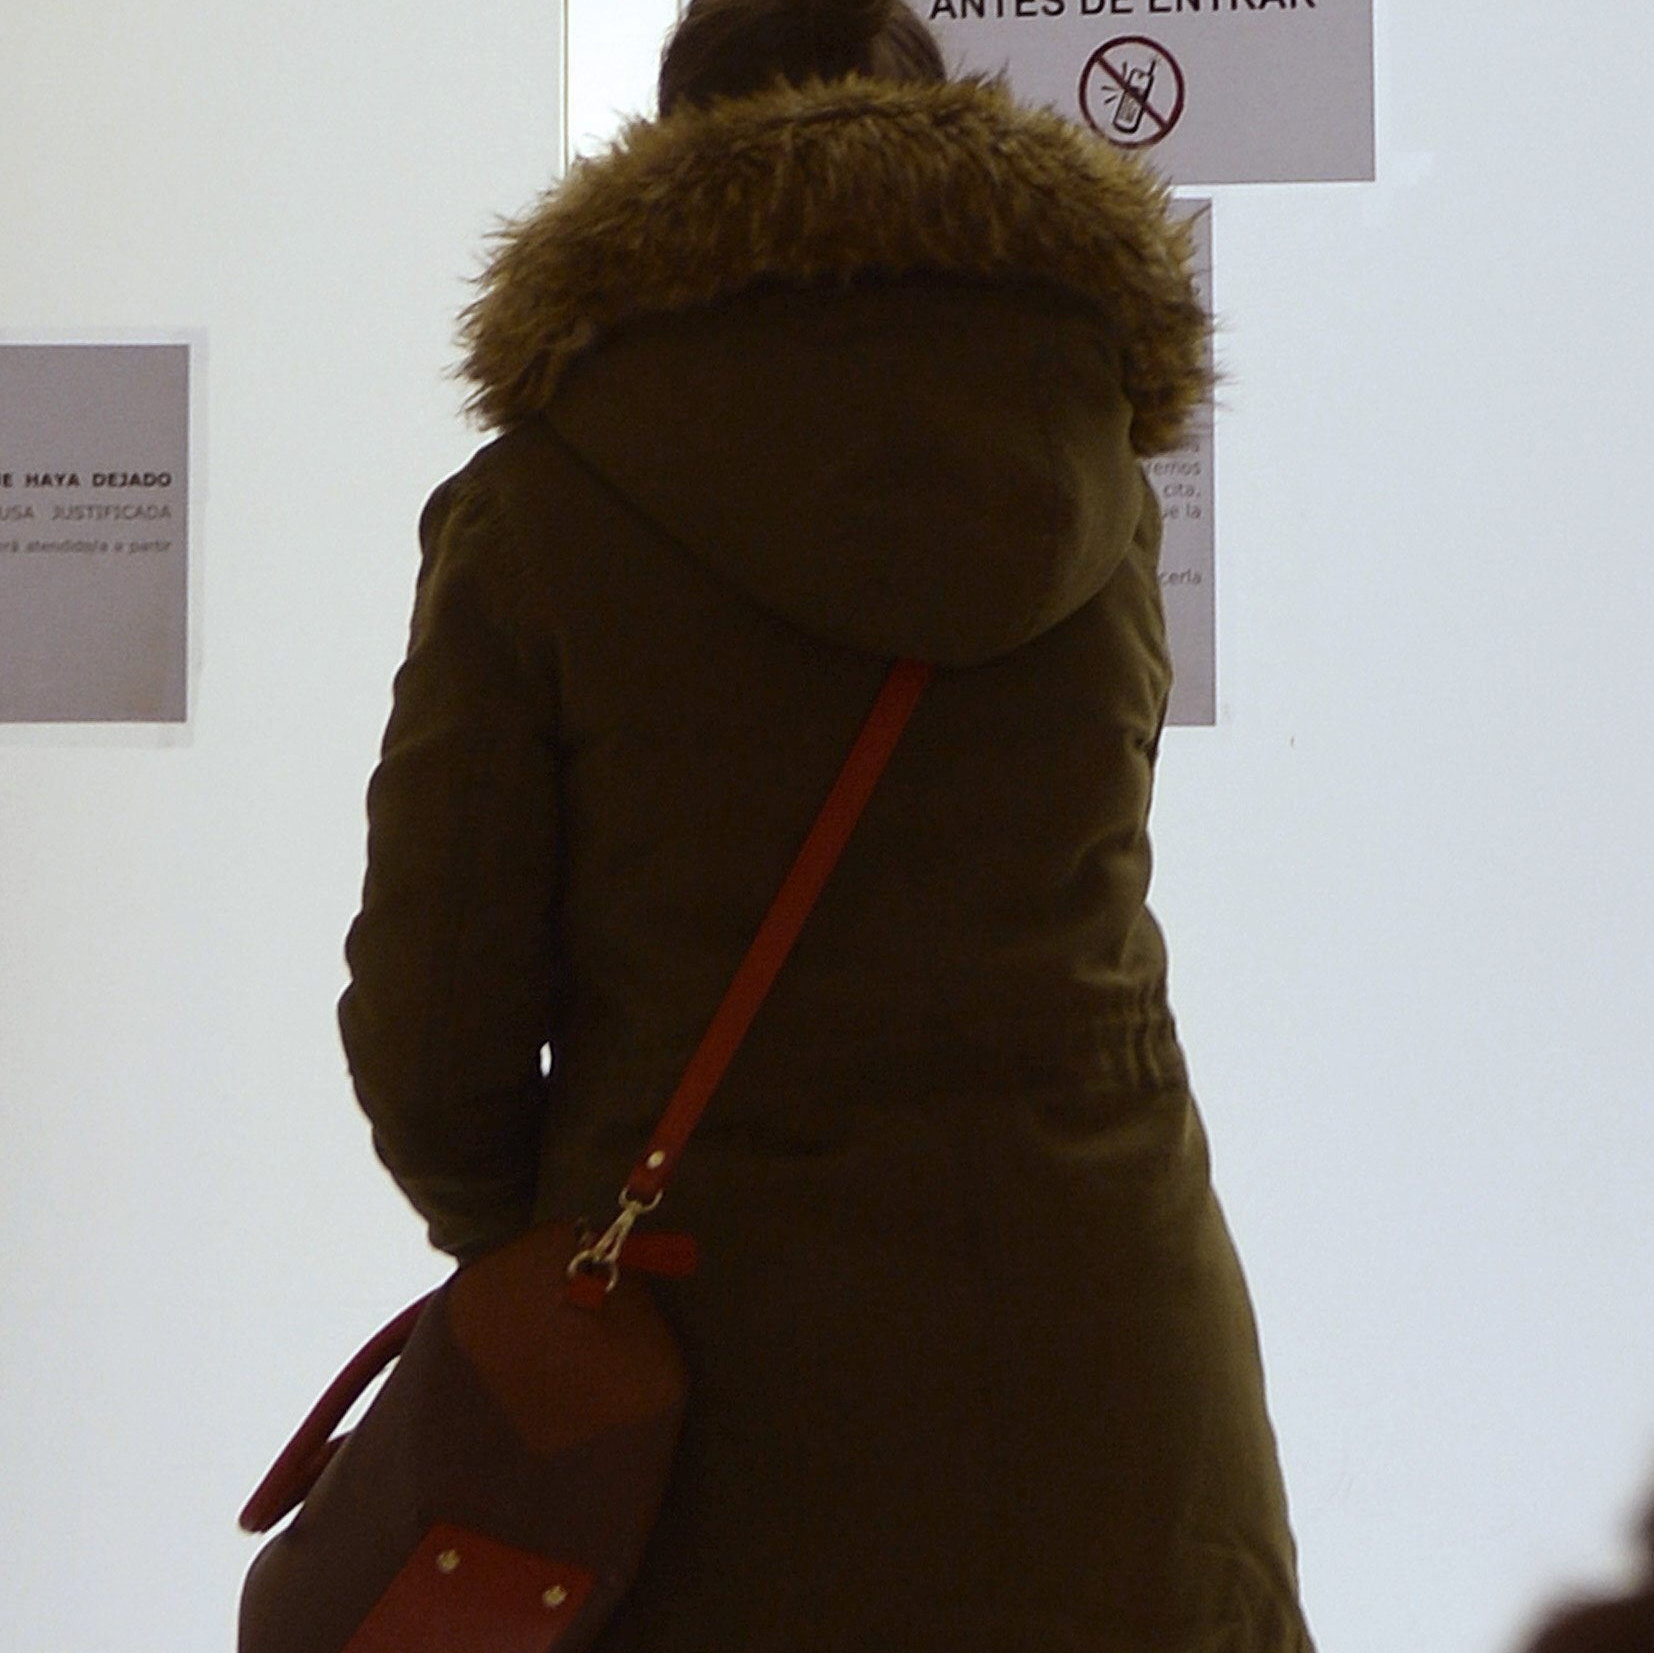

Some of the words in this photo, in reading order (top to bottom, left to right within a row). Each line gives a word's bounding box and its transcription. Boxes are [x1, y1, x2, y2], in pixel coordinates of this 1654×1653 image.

[0, 472, 12, 487] E
[26, 472, 80, 488] HAYA
[92, 471, 172, 488] DEJADO
[52, 503, 172, 521] JUSTIFICADA
